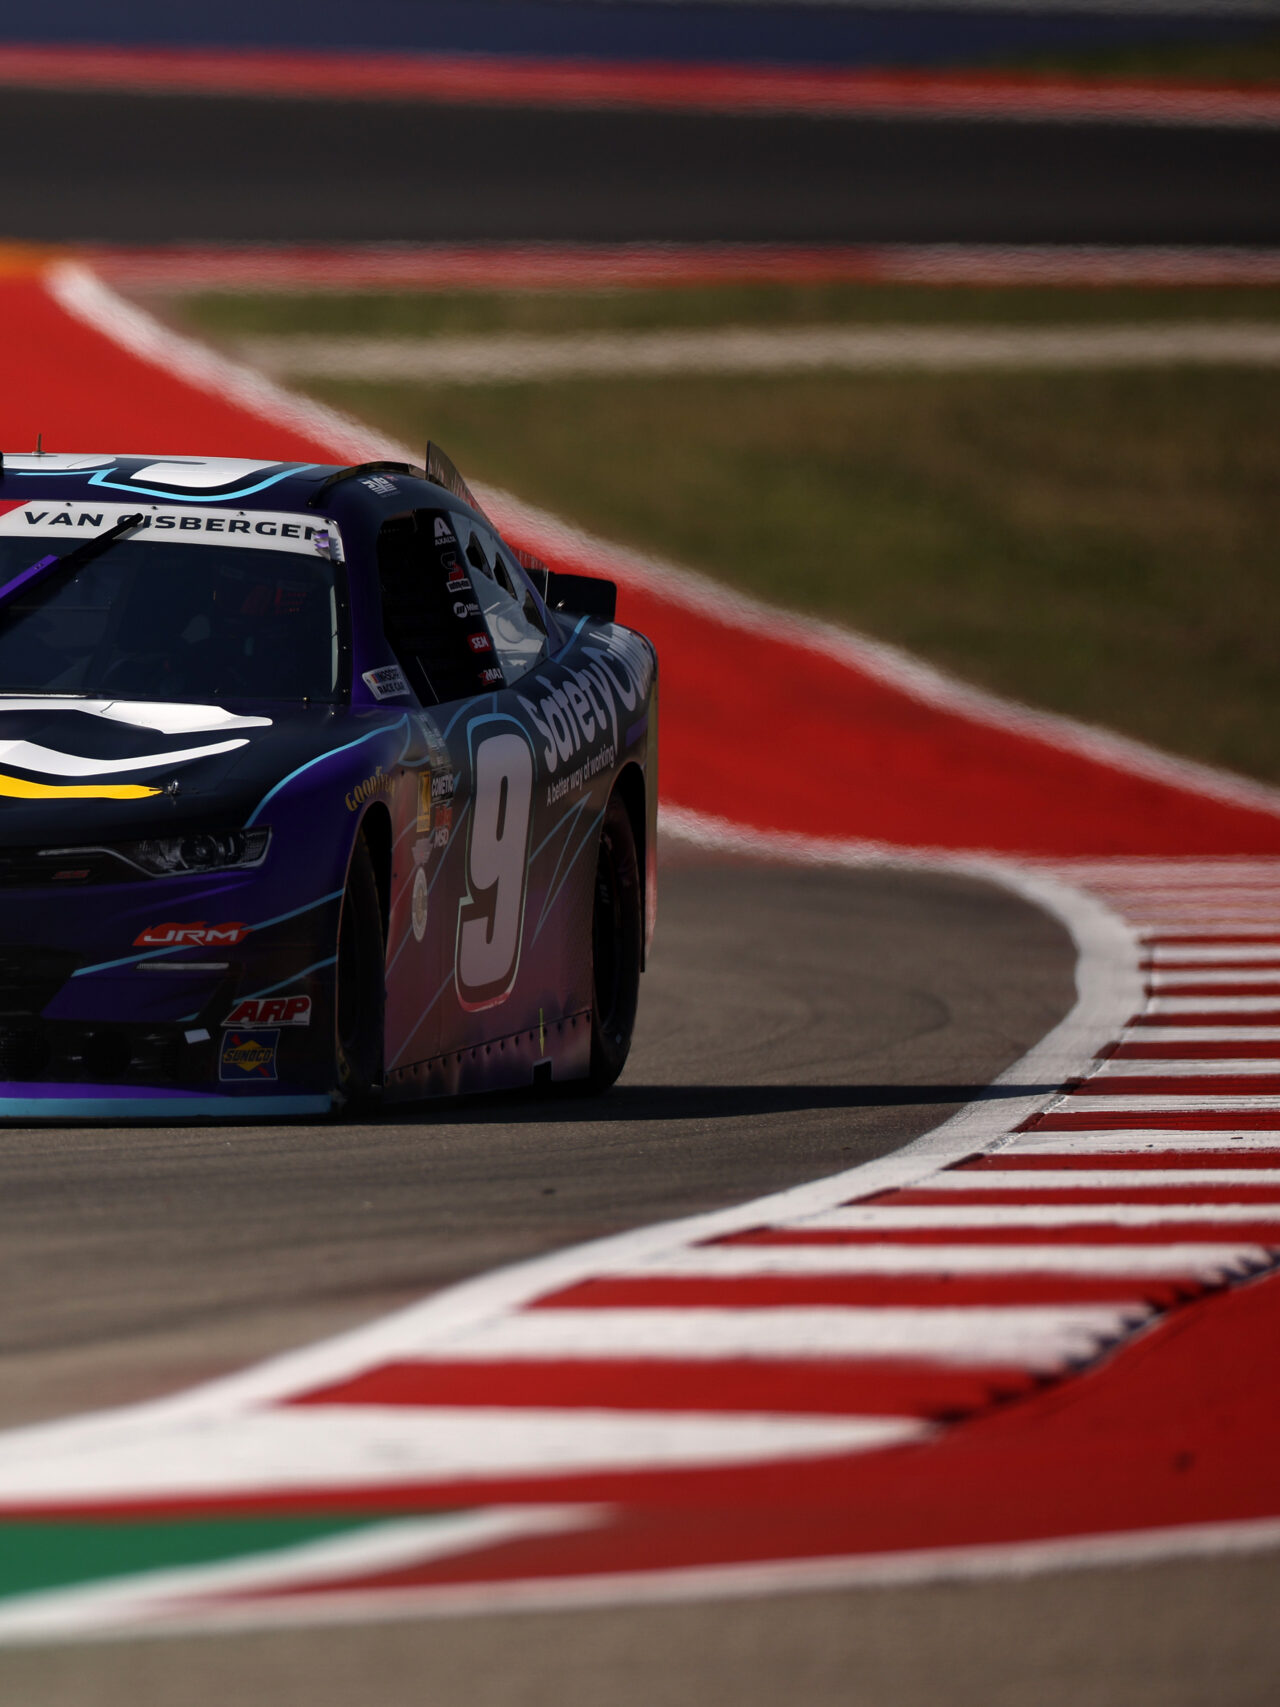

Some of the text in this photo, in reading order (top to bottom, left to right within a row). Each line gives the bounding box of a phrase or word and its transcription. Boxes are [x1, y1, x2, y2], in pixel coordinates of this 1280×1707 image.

[24, 511, 104, 527] VAN
[546, 744, 614, 807] A better way of working
[460, 733, 533, 987] 9
[144, 929, 239, 946] JRM
[227, 997, 310, 1022] ARP
[224, 1049, 272, 1062] SUNOCO
